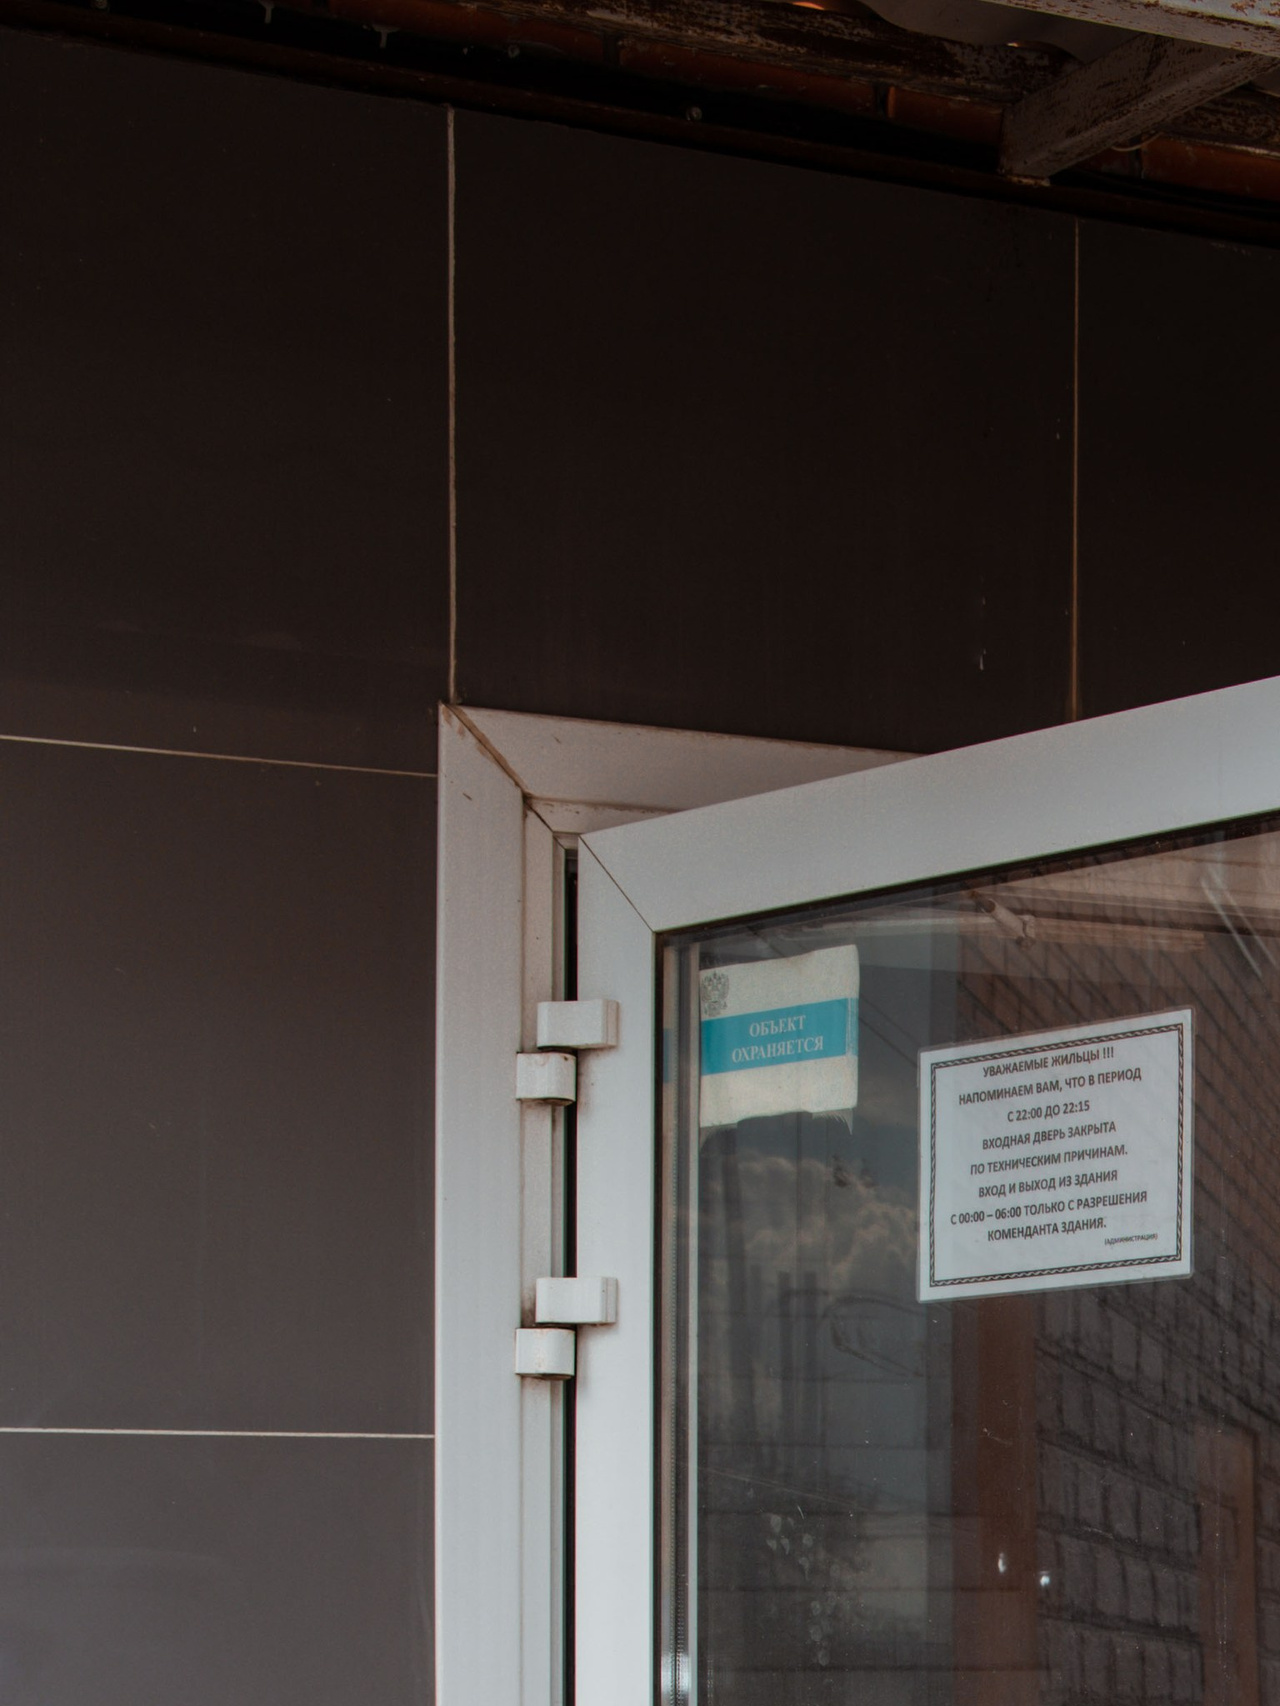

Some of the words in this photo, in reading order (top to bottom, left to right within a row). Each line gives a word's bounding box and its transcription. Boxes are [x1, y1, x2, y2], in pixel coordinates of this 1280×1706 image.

[750, 1015, 806, 1037] ОБЪЕКТ
[732, 1036, 824, 1063] ОХРАНЯЕТСЯ
[983, 1057, 1048, 1078] УВАЖАЕМЫЕ
[1051, 1049, 1100, 1068] ЖИЛЬЦЫ
[1102, 1047, 1114, 1059] !!!
[959, 1087, 1034, 1105] НАПОМИНАЕМ
[1036, 1079, 1062, 1094] ВАМ,
[1065, 1077, 1085, 1089] ЧТО
[1088, 1075, 1095, 1086] В
[1098, 1068, 1142, 1085] ПЕРИОД
[1007, 1111, 1014, 1122] С
[1016, 1108, 1042, 1122] 22:00
[1045, 1106, 1060, 1120] ДО
[1063, 1101, 1090, 1115] 22:15
[982, 1134, 1031, 1151] ВХОДНАЯ
[1033, 1128, 1065, 1147] ДВЕРЬ
[1068, 1122, 1116, 1139] ЗАКРЫТА
[970, 1163, 985, 1176] ПО
[988, 1152, 1061, 1174] ТЕХНИЧЕСКИМ
[1064, 1145, 1128, 1163] ПРИЧИНАМ.
[978, 1184, 1007, 1198] ВХОД
[1009, 1183, 1016, 1194] И
[1018, 1177, 1056, 1193] ВЫХОД
[1059, 1176, 1072, 1188] ИЗ
[1074, 1170, 1118, 1188] ЗДАНИЯ
[950, 1213, 957, 1225] С
[959, 1210, 985, 1224] 00:00
[994, 1206, 1021, 1220] 06:00
[1024, 1202, 1065, 1217] ТОЛЬКО
[1068, 1199, 1074, 1211] С
[1077, 1191, 1148, 1210] РАЗРЕШЕНИЯ
[987, 1222, 1059, 1242] КОМЕНДАНТА
[1062, 1217, 1107, 1234] ЗДАНИЯ.
